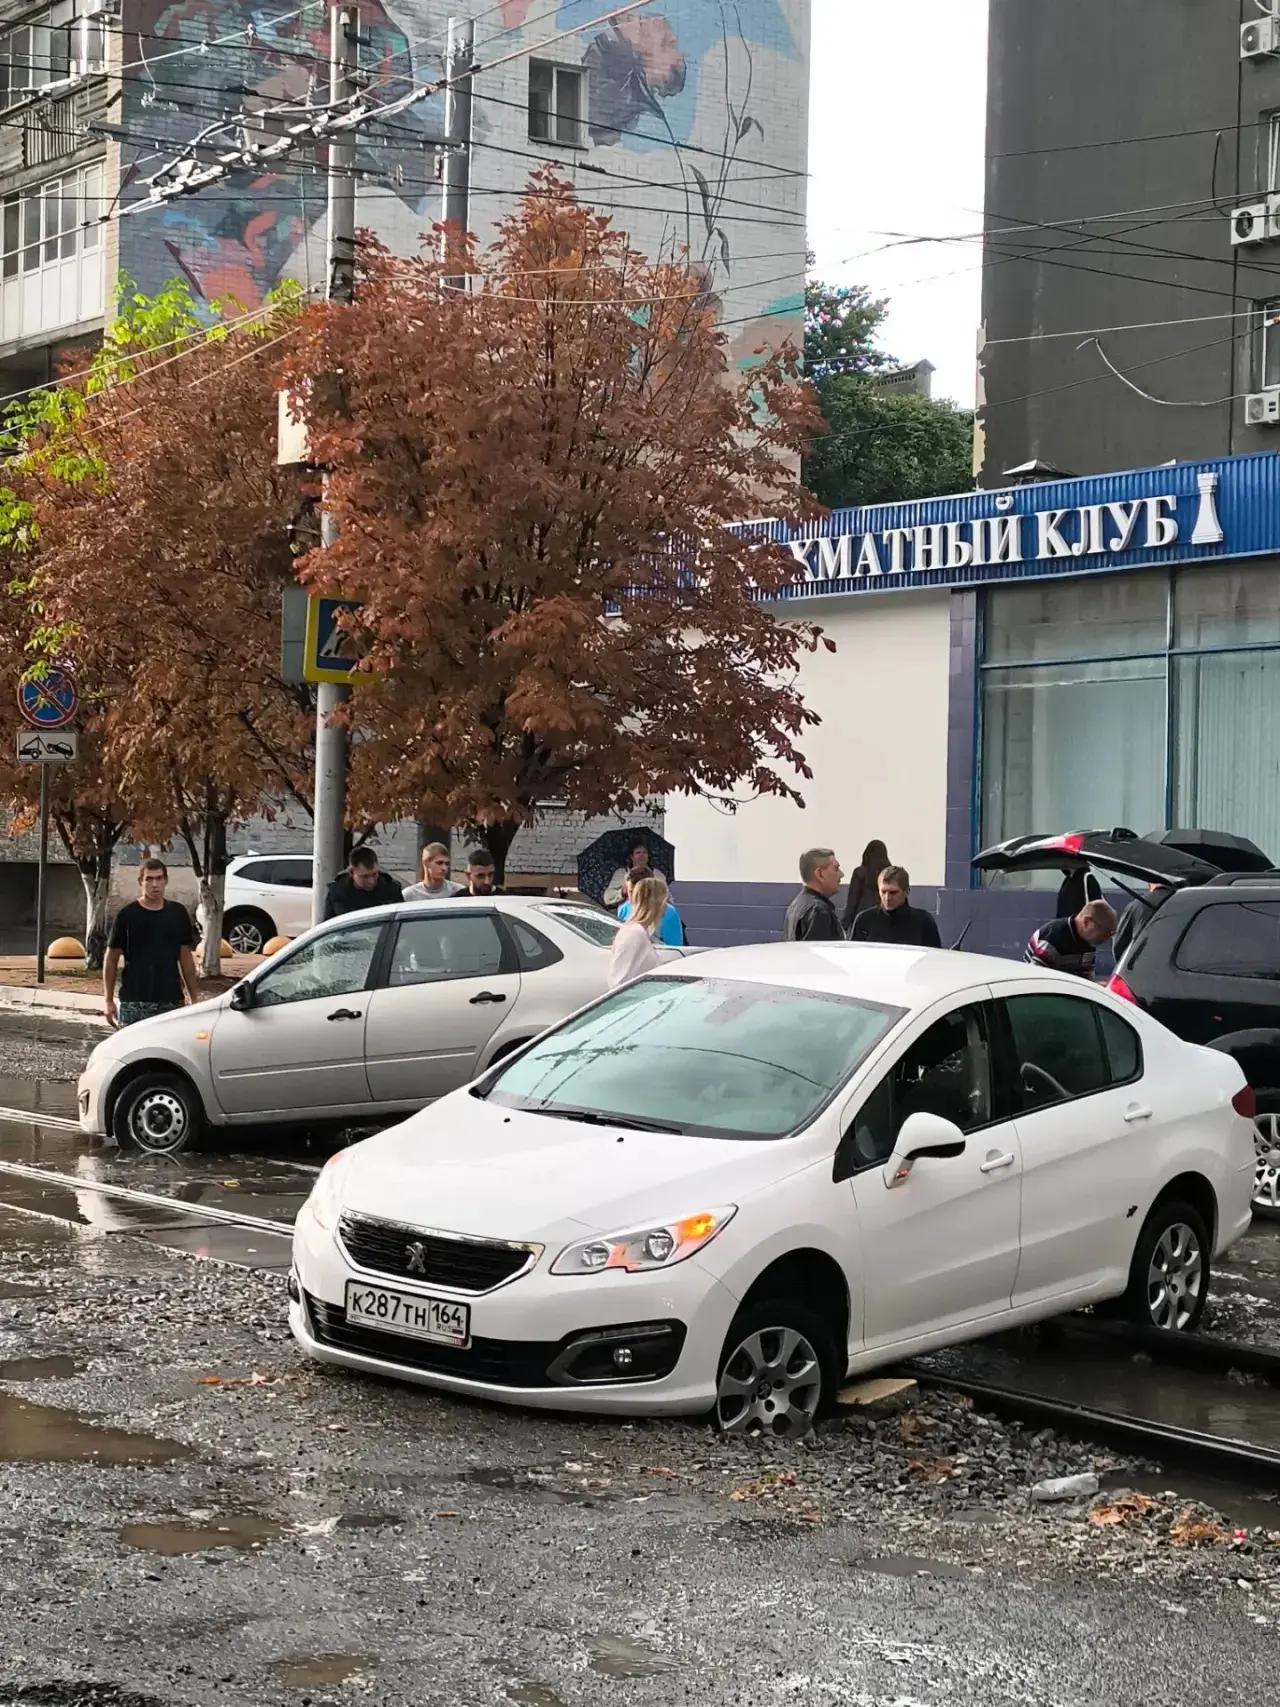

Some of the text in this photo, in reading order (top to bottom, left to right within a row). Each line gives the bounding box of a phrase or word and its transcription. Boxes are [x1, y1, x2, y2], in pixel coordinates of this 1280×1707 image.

[750, 495, 1179, 586] ХМАТНЫЙ КЛУБ
[431, 1303, 461, 1327] 164
[436, 1323, 453, 1333] RUS
